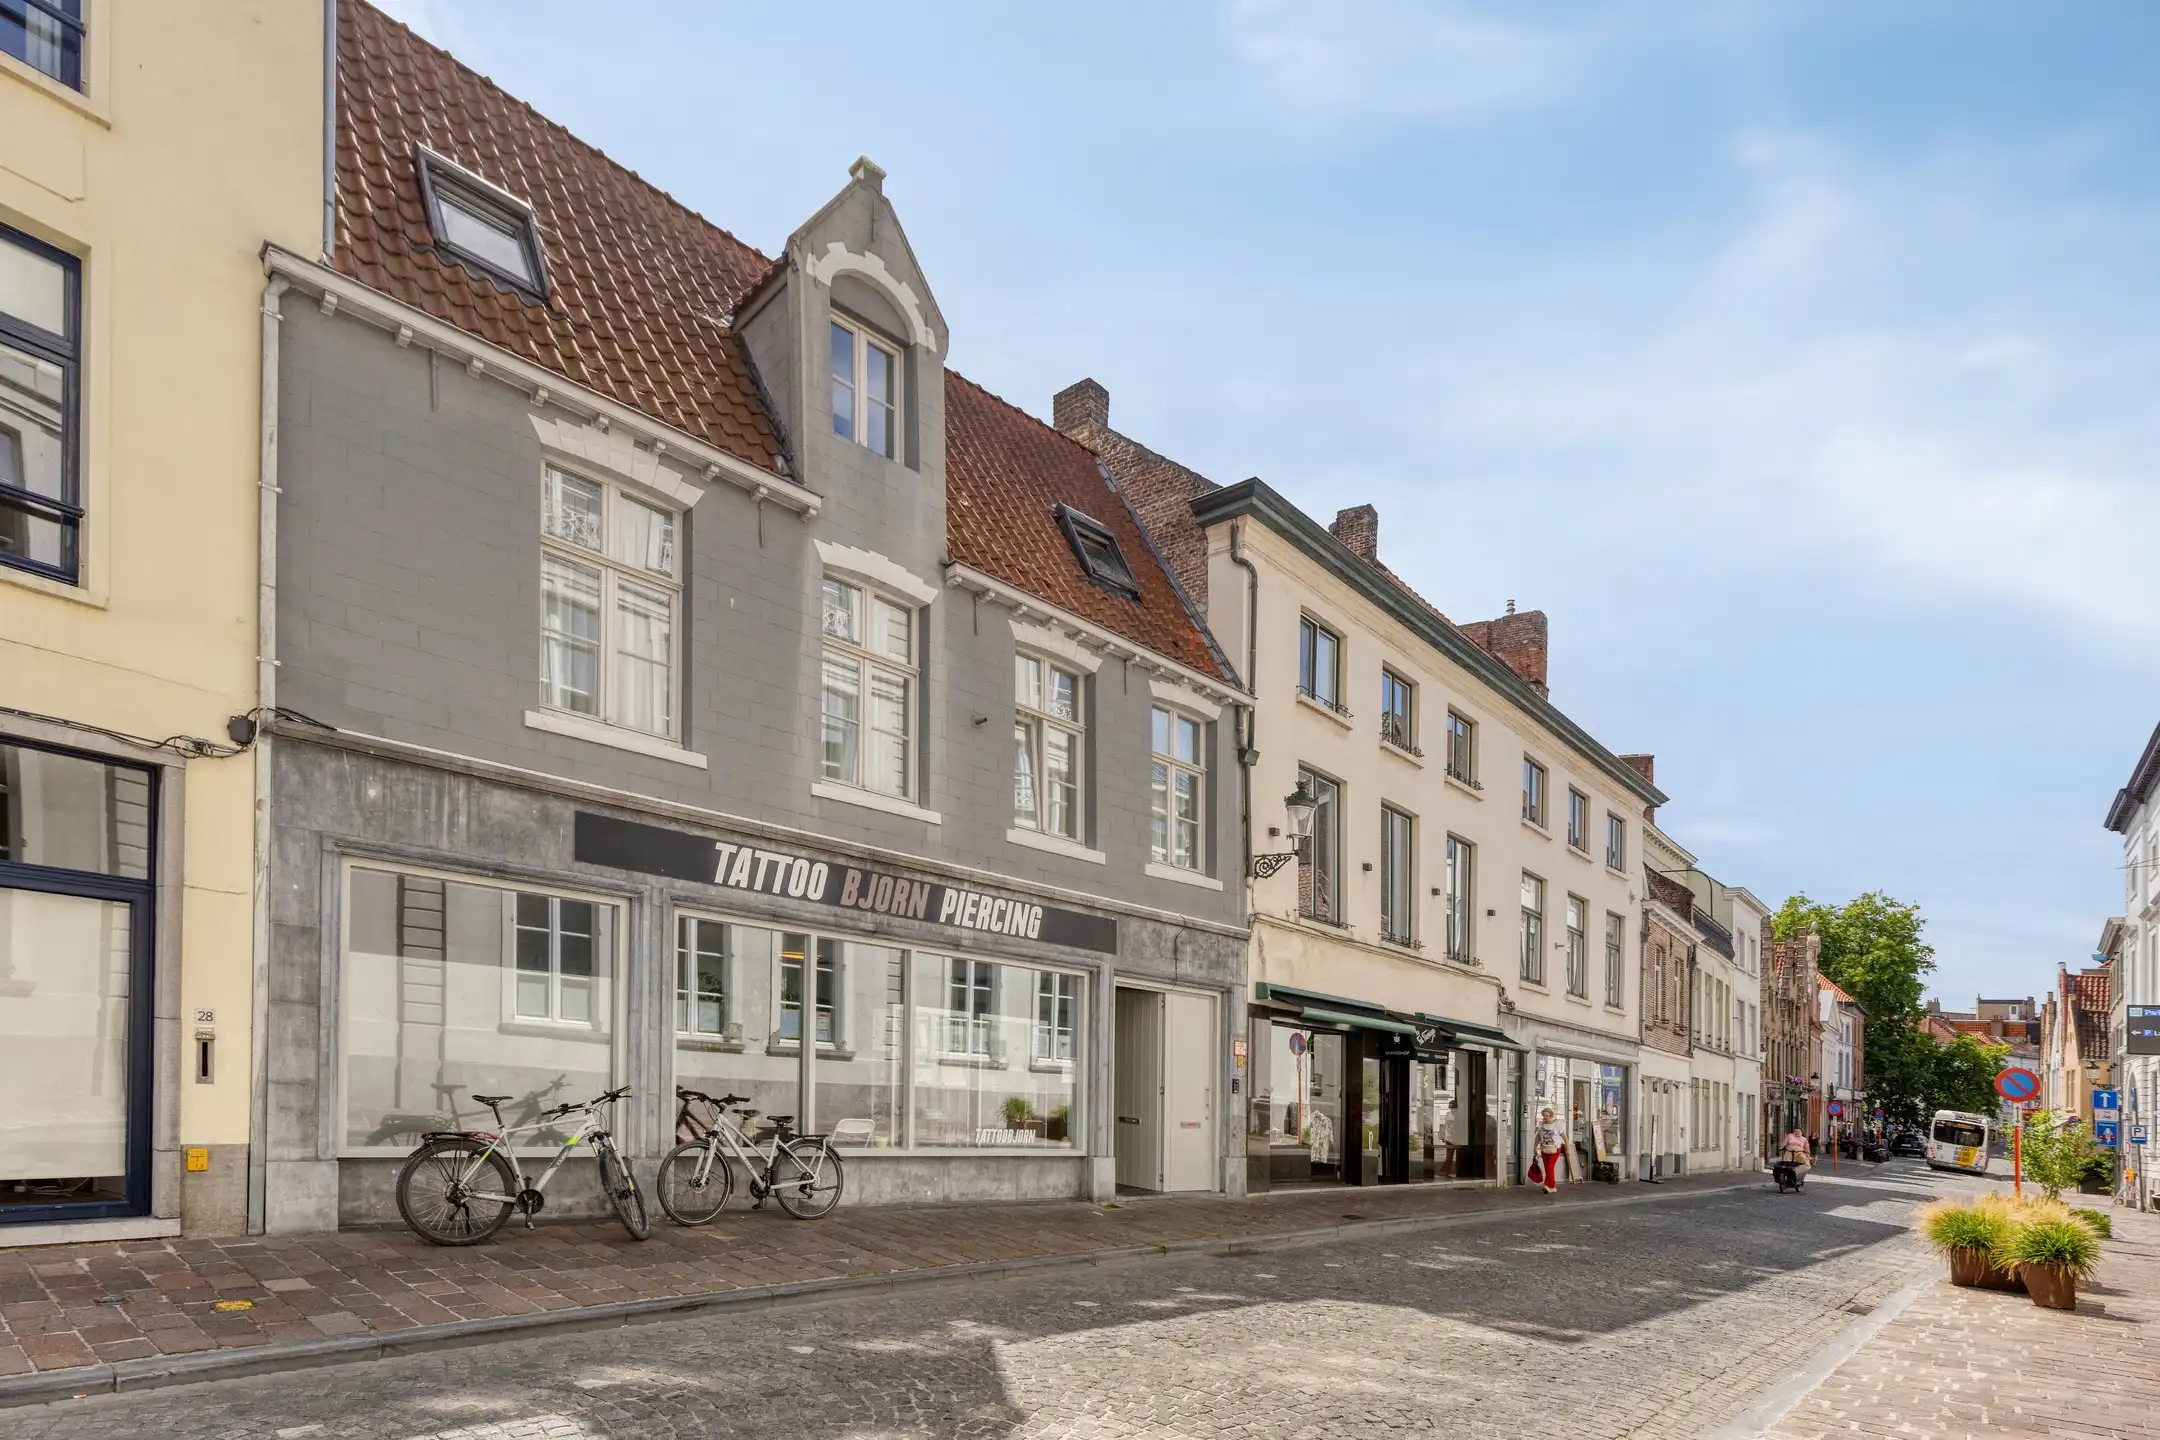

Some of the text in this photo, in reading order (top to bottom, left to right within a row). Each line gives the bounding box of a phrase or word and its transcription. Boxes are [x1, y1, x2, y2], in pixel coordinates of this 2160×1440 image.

[714, 842, 1043, 939] TATTOO BJORN PIERCING
[197, 1010, 214, 1022] 28
[975, 1128, 1037, 1144] TATTOOBJORN
[2133, 1127, 2142, 1136] P
